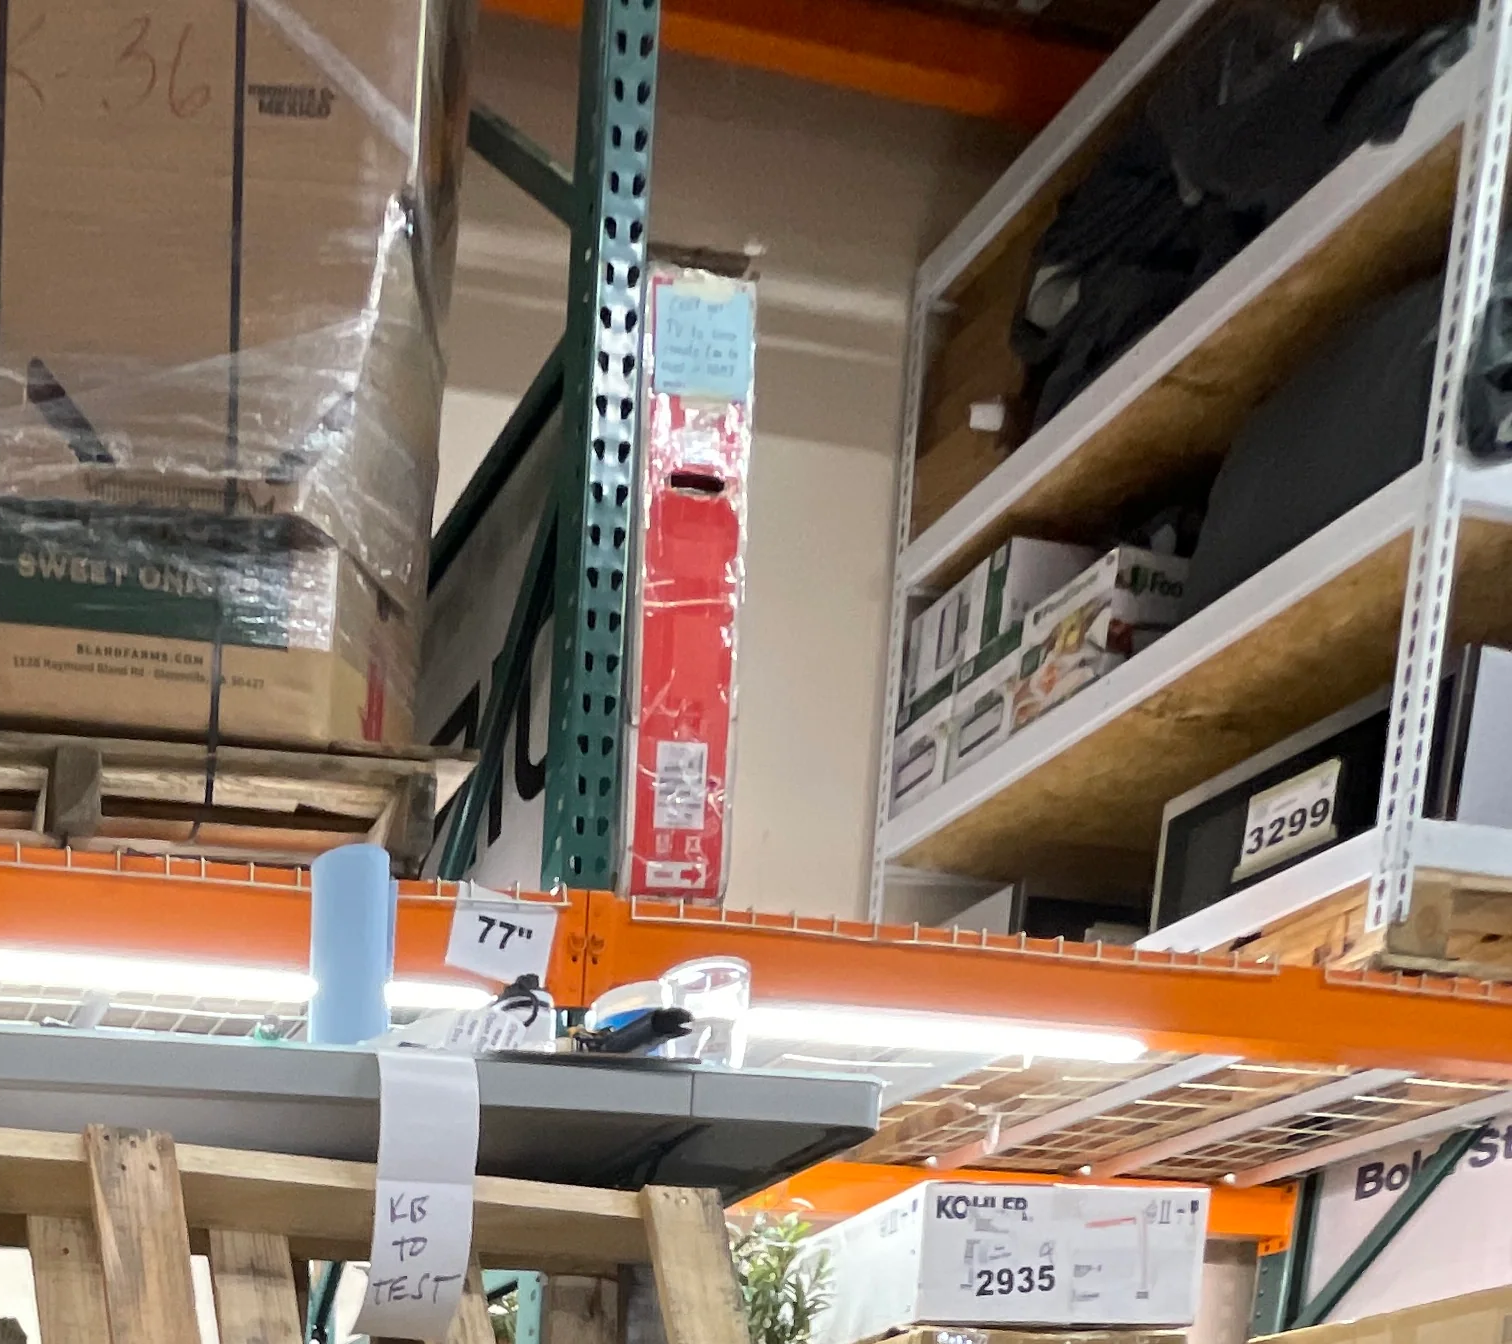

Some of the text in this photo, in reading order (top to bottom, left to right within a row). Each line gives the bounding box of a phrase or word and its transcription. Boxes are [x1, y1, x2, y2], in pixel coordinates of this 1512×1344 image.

[17, 550, 129, 588] SWEET
[1246, 797, 1330, 855] 3299
[478, 914, 533, 950] 77"
[1355, 1149, 1434, 1201] Bol
[390, 1192, 430, 1224] KB
[392, 1236, 428, 1262] TO
[372, 1272, 462, 1306] TEST
[976, 1264, 1056, 1297] 2935
